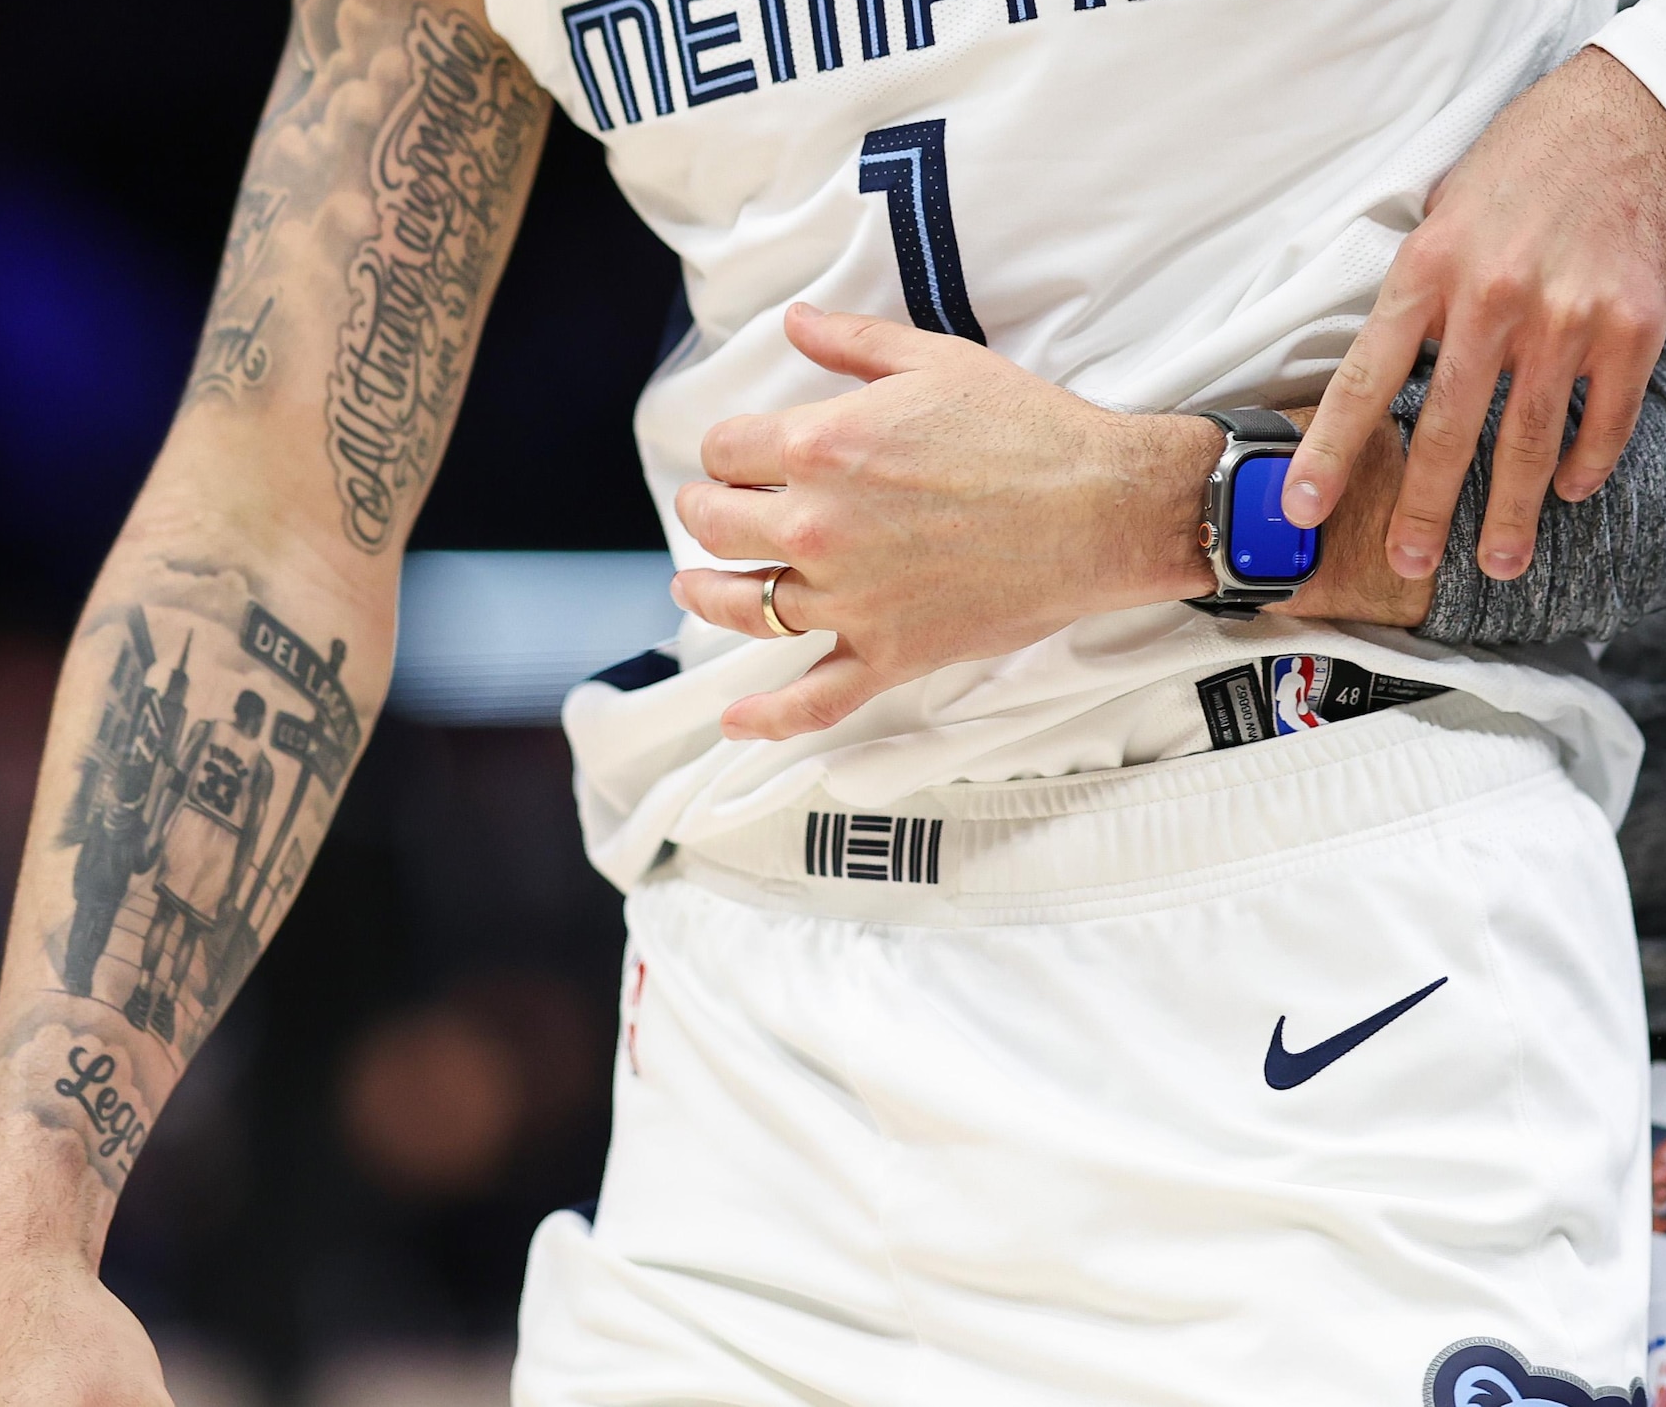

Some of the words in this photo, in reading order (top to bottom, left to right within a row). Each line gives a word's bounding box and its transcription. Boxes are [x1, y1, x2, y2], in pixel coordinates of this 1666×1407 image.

[859, 119, 987, 346] 1
[254, 623, 300, 677] DEL
[1335, 686, 1360, 705] 48
